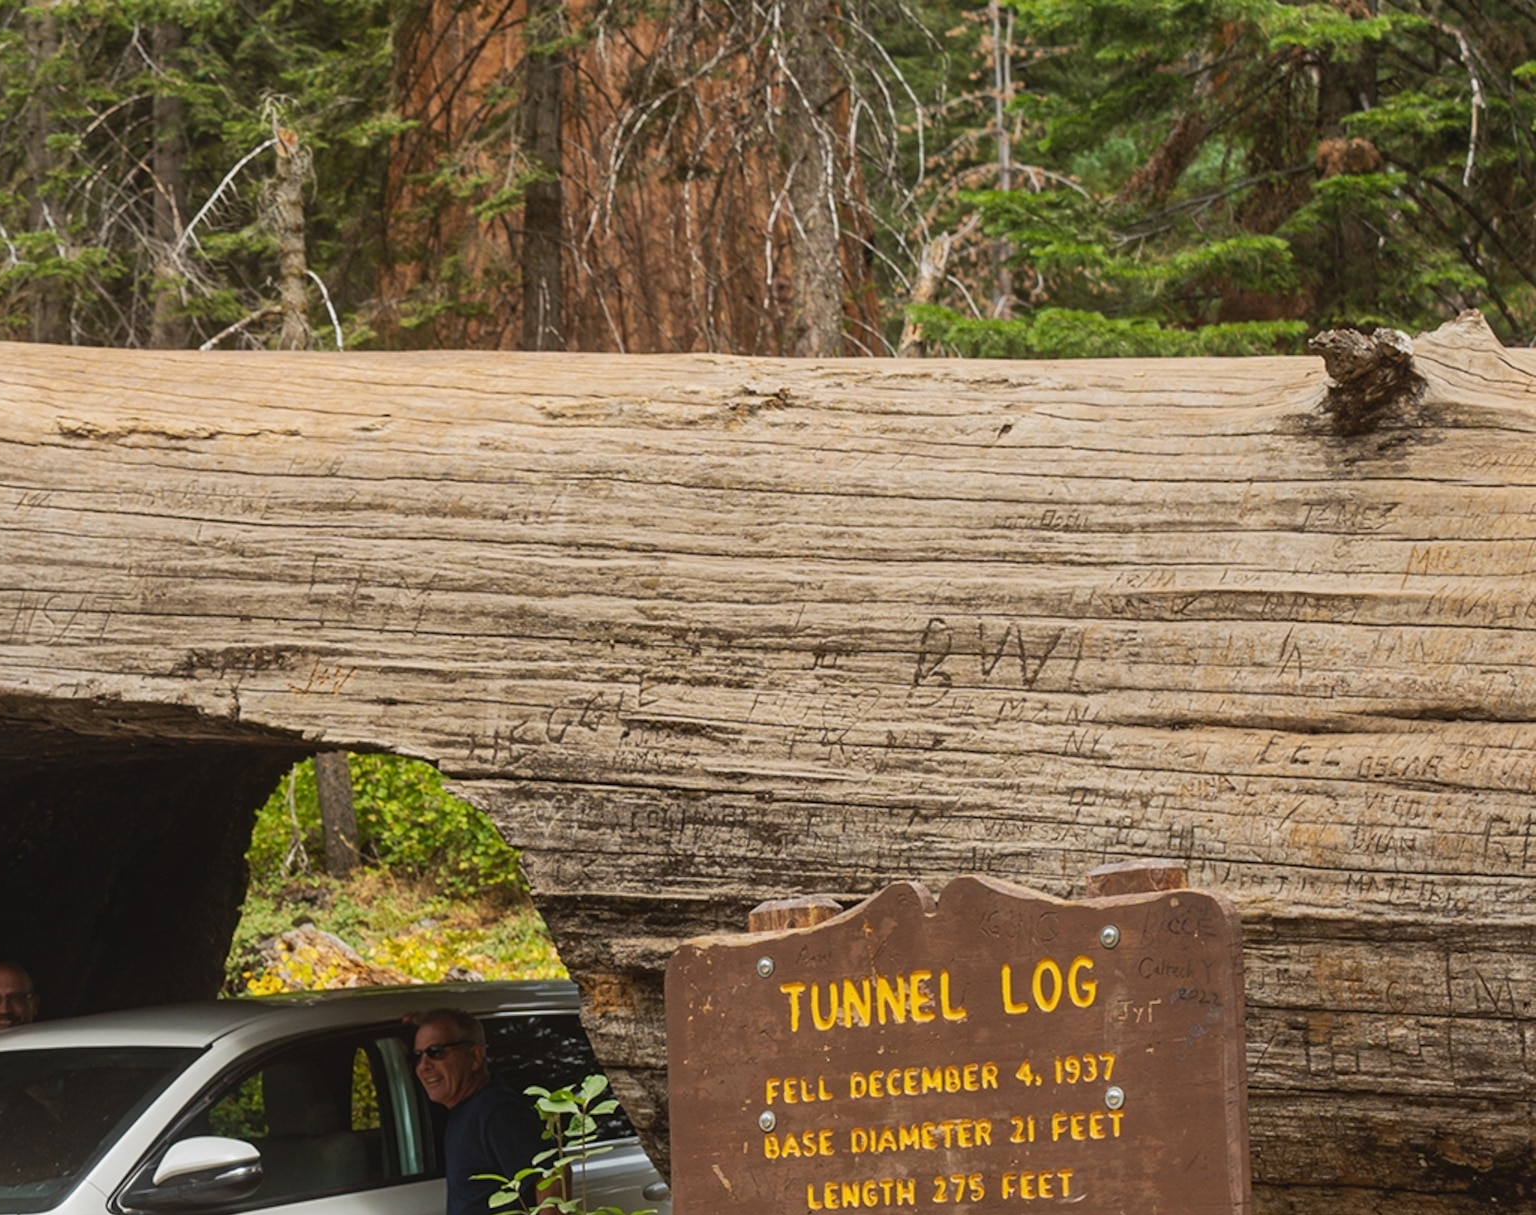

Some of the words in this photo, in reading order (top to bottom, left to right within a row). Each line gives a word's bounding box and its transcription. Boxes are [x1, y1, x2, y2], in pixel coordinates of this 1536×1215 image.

[779, 969, 968, 1034] TUNNEL
[1001, 955, 1098, 1016] LOG
[765, 1076, 834, 1105] FELL
[849, 1061, 999, 1100] DECEMBER
[1015, 1059, 1043, 1087] 4,
[1053, 1051, 1117, 1084] 1937
[763, 1128, 835, 1160] BASE
[850, 1117, 993, 1155] DIAMETER
[1009, 1115, 1036, 1144] 21
[1051, 1109, 1125, 1142] FEET
[806, 1178, 917, 1211] LENGTH
[931, 1172, 986, 1204] 275
[1000, 1169, 1075, 1200] FEET
